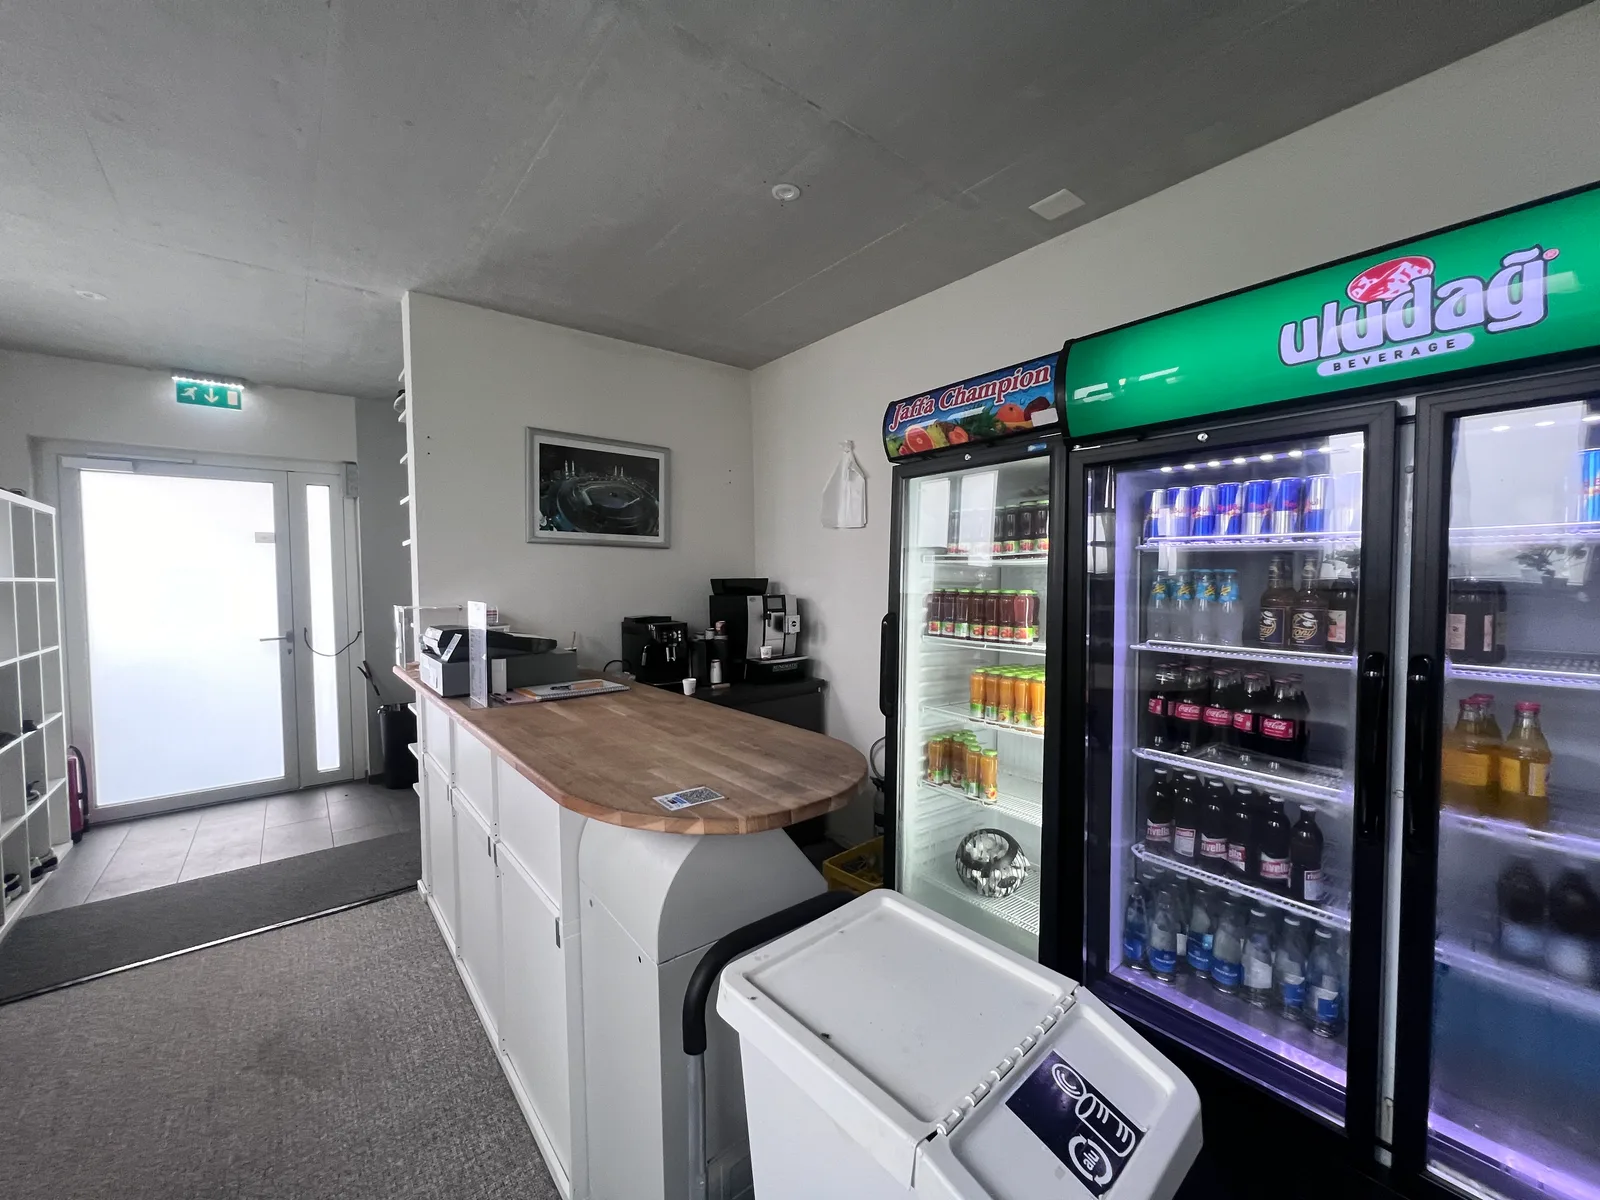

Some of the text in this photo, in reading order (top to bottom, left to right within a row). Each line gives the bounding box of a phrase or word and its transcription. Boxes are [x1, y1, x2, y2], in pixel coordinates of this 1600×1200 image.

[1279, 246, 1547, 366] uludağ
[1332, 337, 1456, 371] BEVERAGE
[889, 365, 1052, 431] Jaffa Champion
[1201, 842, 1226, 852] rivella
[1083, 1149, 1098, 1171] alu
